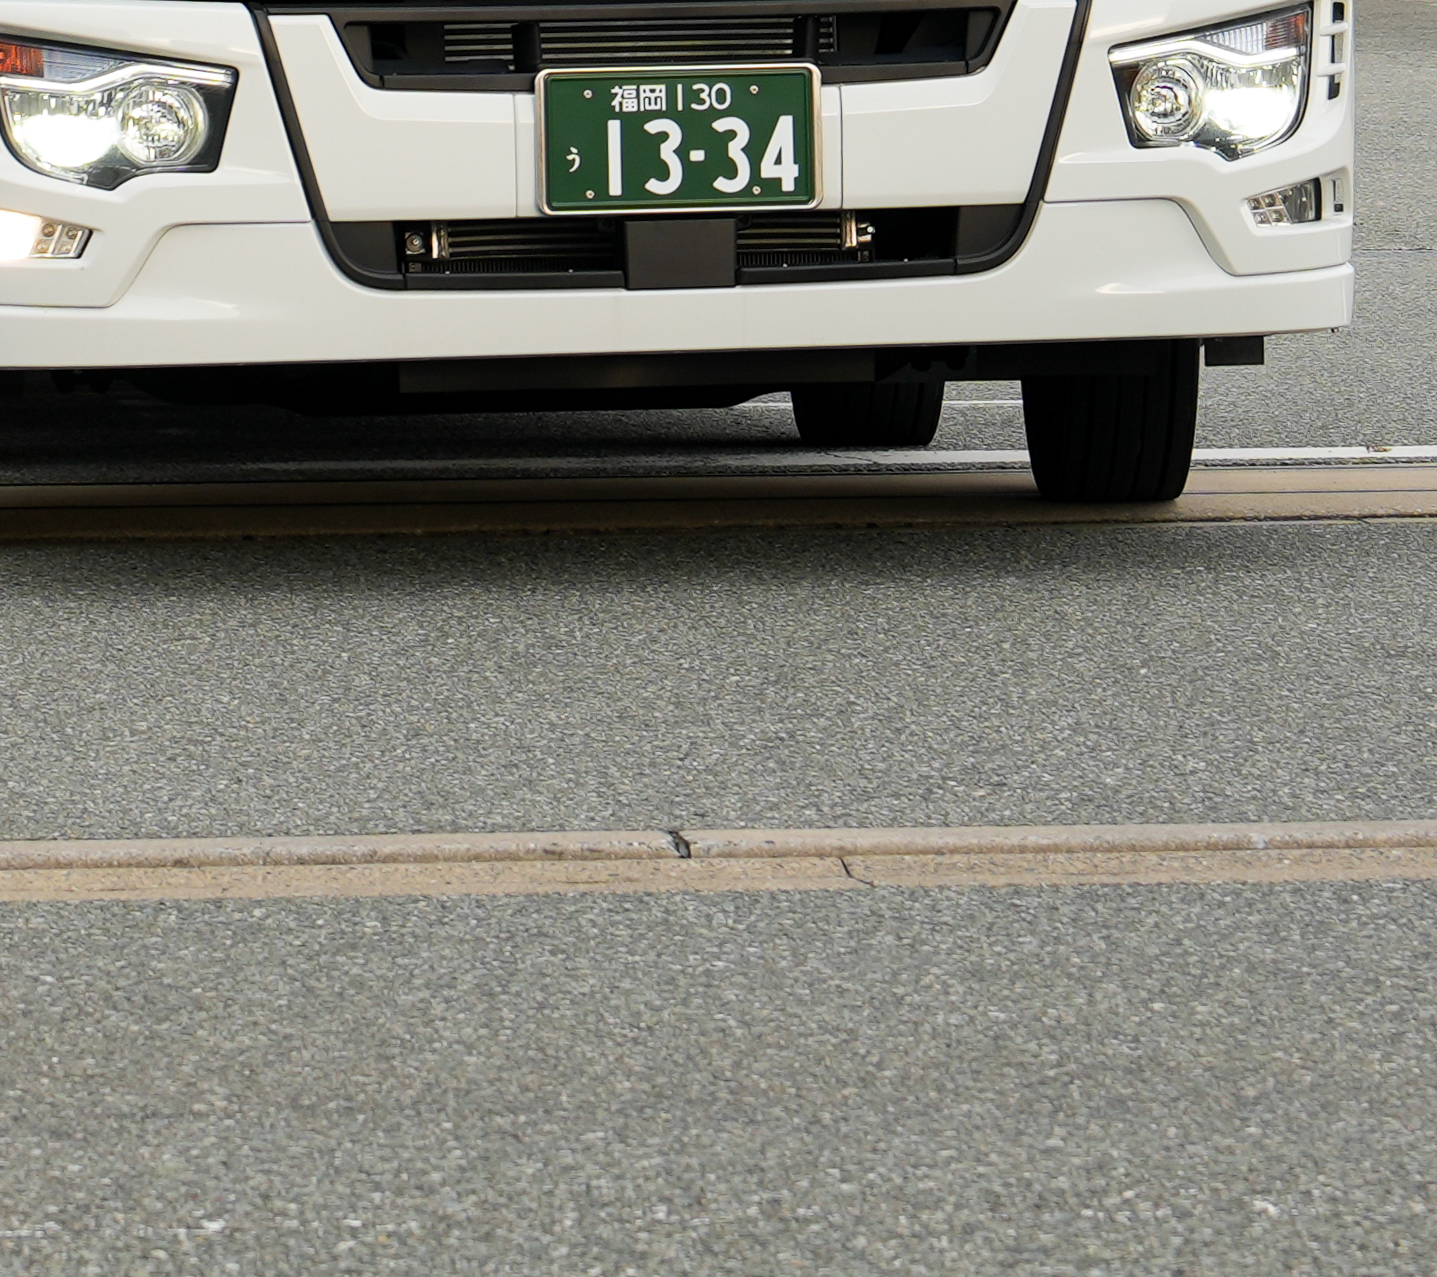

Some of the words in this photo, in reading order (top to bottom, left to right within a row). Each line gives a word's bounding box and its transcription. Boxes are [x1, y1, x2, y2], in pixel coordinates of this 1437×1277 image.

[610, 83, 667, 113] 福岡
[676, 82, 732, 112] 130
[565, 147, 581, 173] う
[607, 115, 800, 197] 13-34
